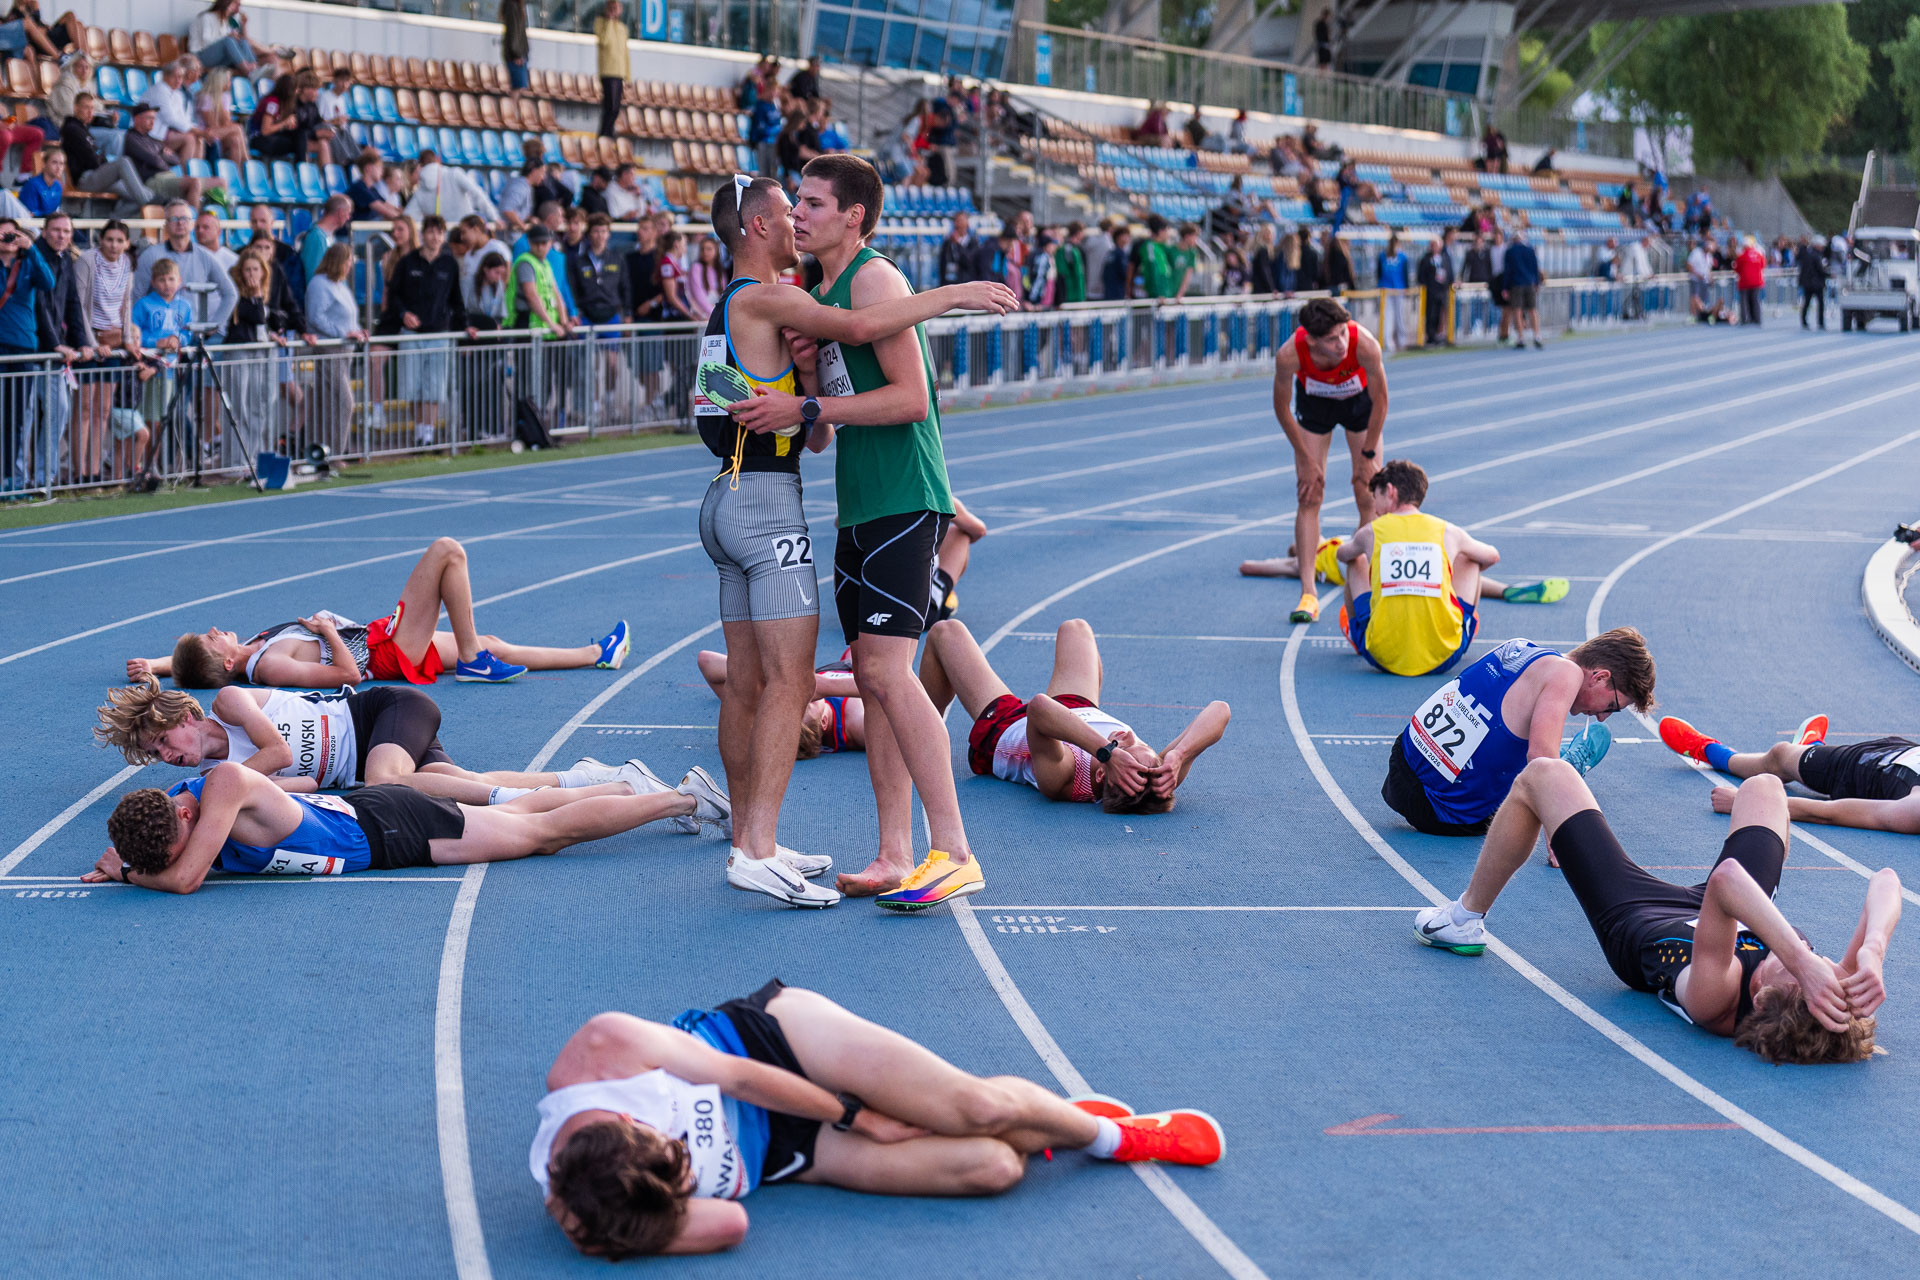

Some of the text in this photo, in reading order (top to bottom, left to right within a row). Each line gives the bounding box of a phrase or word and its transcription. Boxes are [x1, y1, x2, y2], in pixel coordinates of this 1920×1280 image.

[645, 0, 665, 35] D
[776, 536, 812, 568] 22
[1390, 559, 1431, 580] 304
[866, 612, 893, 626] 4F
[1455, 699, 1481, 729] LUBELSKIE
[1423, 703, 1466, 758] 872
[327, 753, 336, 775] LUBLIN
[1413, 734, 1441, 768] LUBLIN 2026
[992, 915, 1066, 923] 400
[694, 1099, 714, 1149] 380
